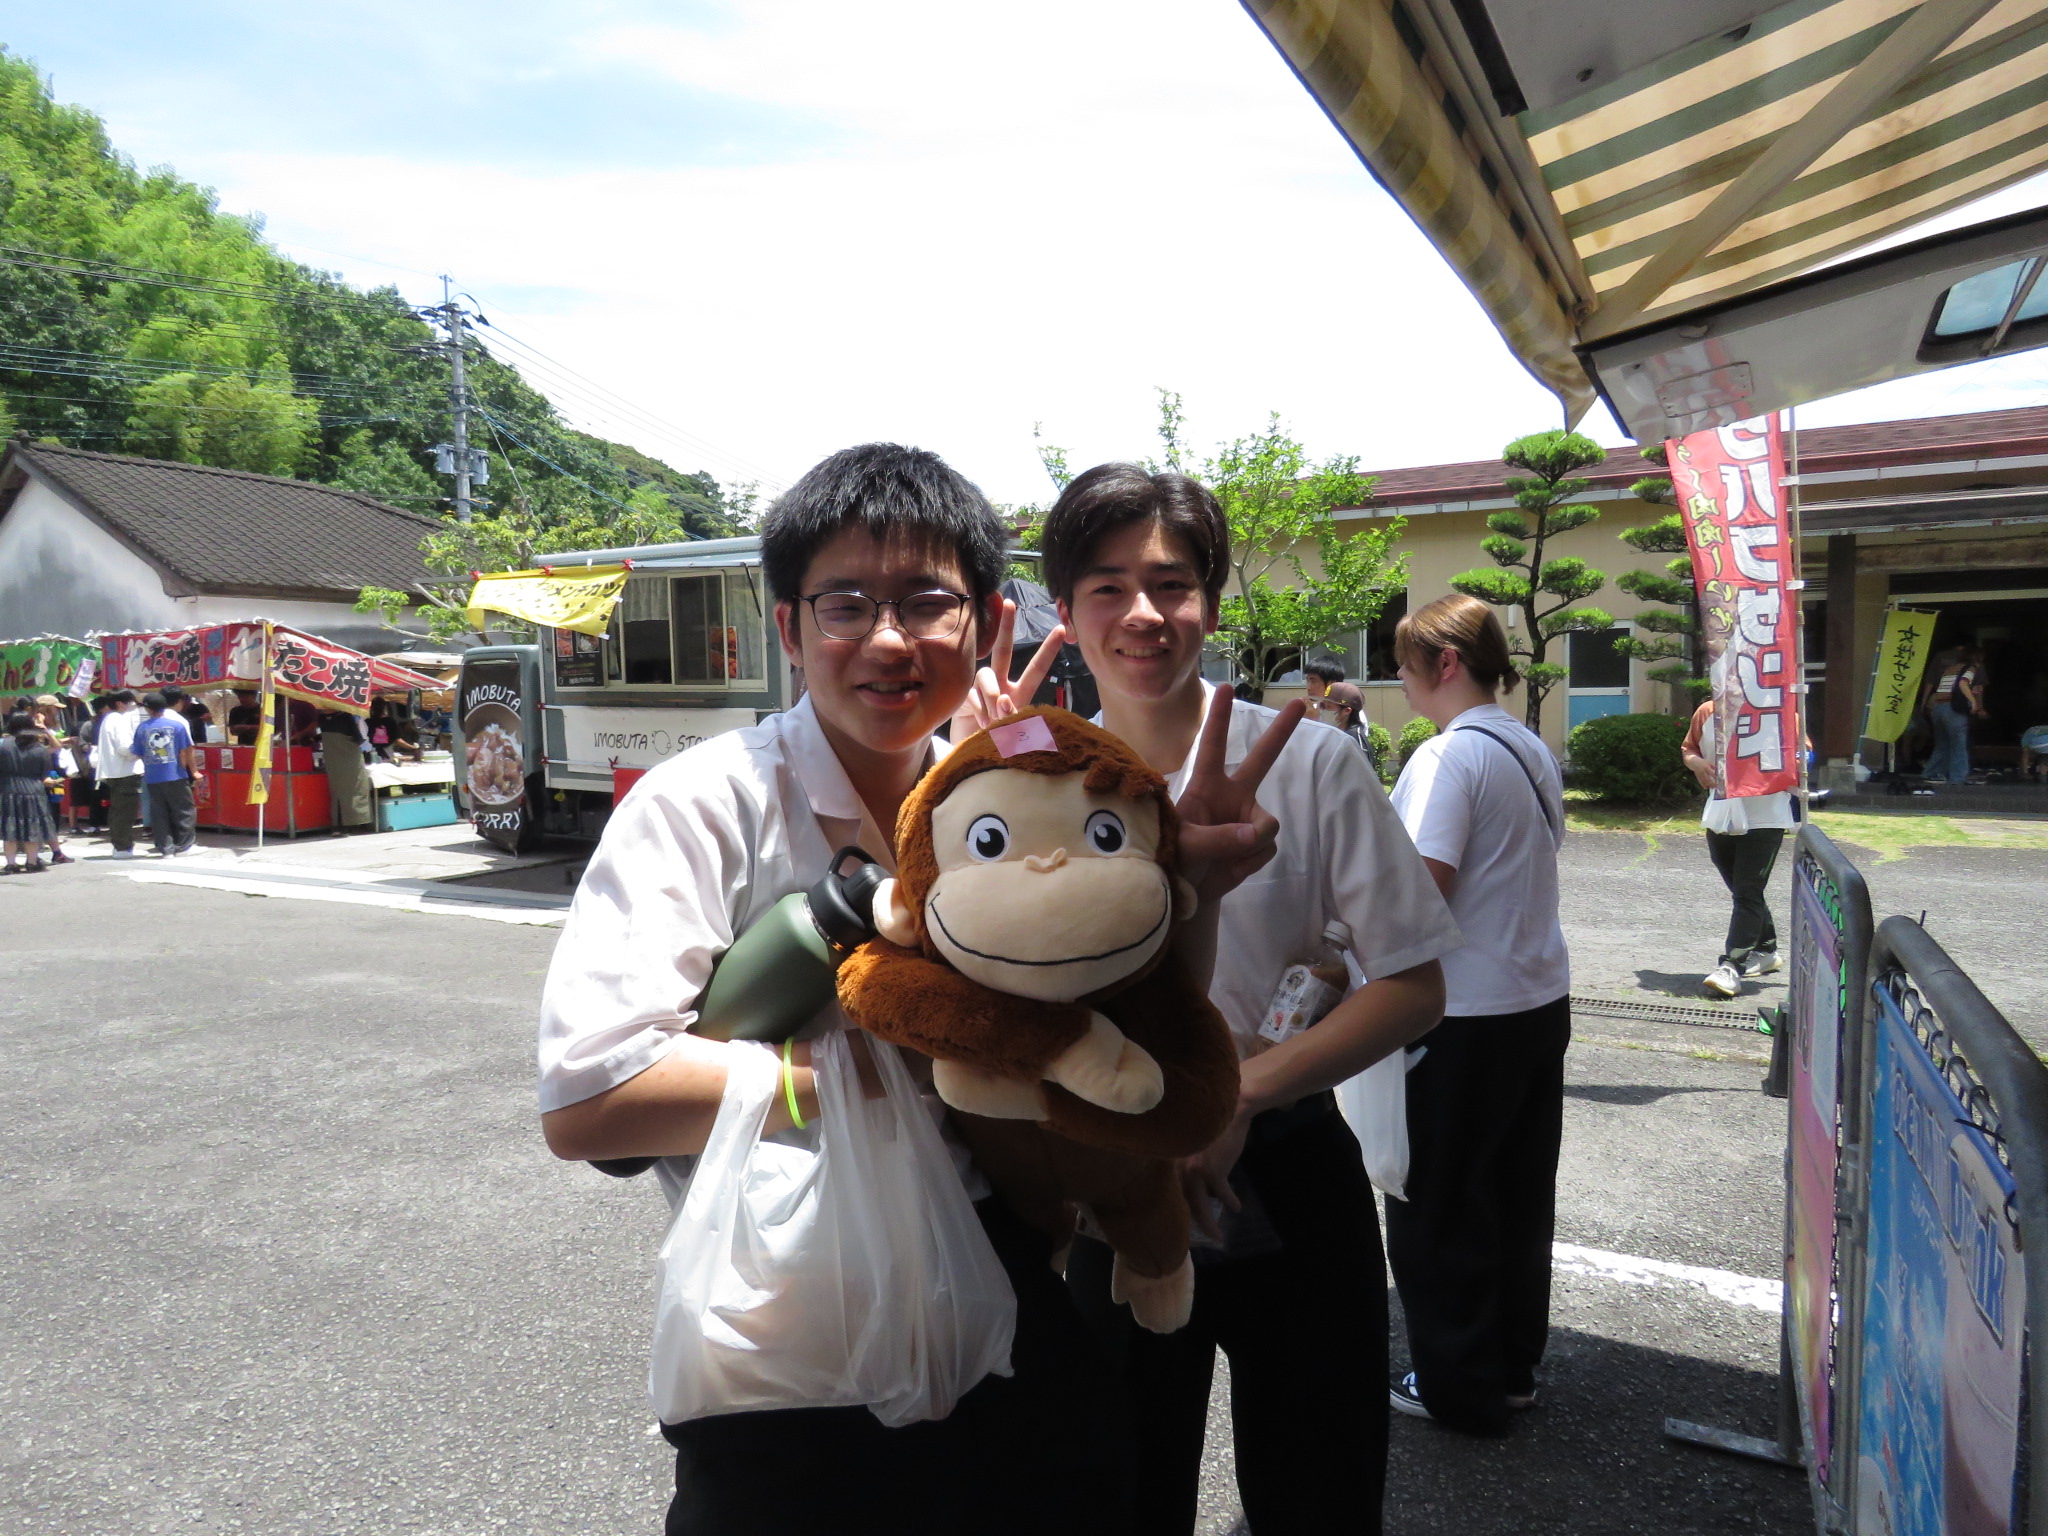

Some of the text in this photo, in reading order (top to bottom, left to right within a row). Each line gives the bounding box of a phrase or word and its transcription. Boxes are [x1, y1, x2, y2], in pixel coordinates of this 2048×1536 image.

[150, 634, 201, 683] たこ焼
[273, 641, 371, 705] たこ焼
[466, 684, 521, 712] IMOBUTA
[594, 732, 648, 750] IMOBUTA
